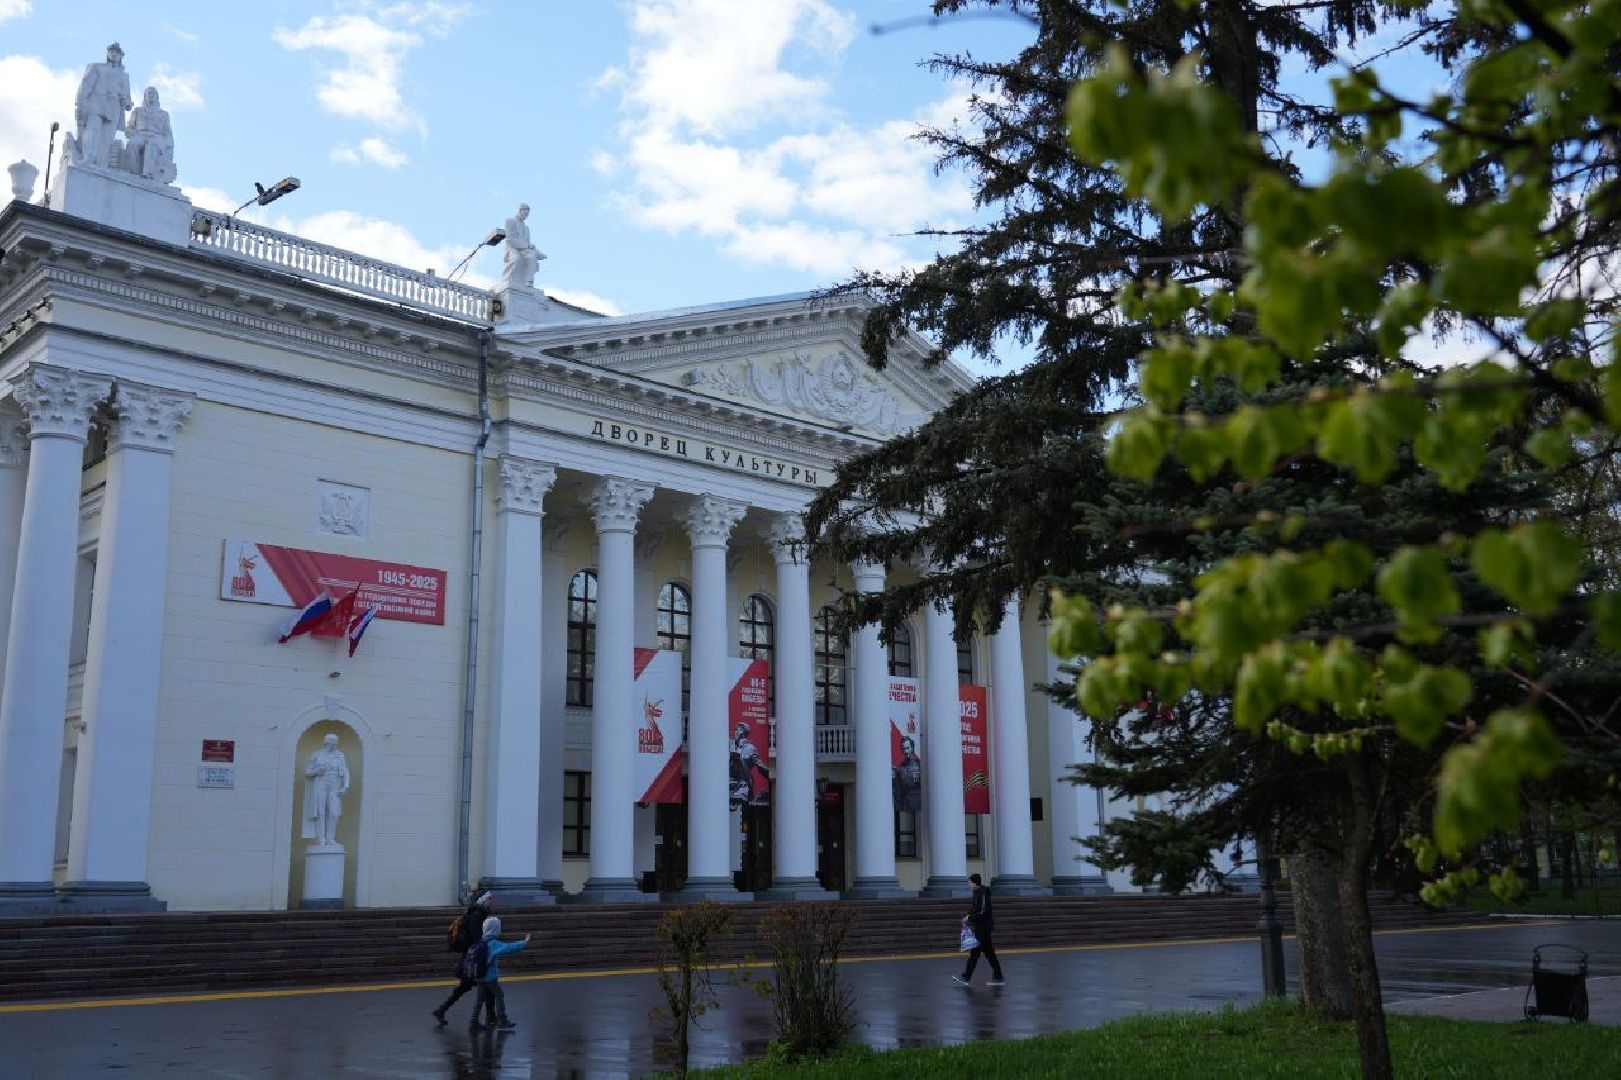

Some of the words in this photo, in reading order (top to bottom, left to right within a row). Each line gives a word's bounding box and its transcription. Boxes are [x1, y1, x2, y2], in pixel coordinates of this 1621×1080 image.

[592, 420, 687, 458] ДВОРЕЦ
[706, 445, 816, 484] КУЛЬТУРЫ
[377, 569, 438, 590] 1945-2025
